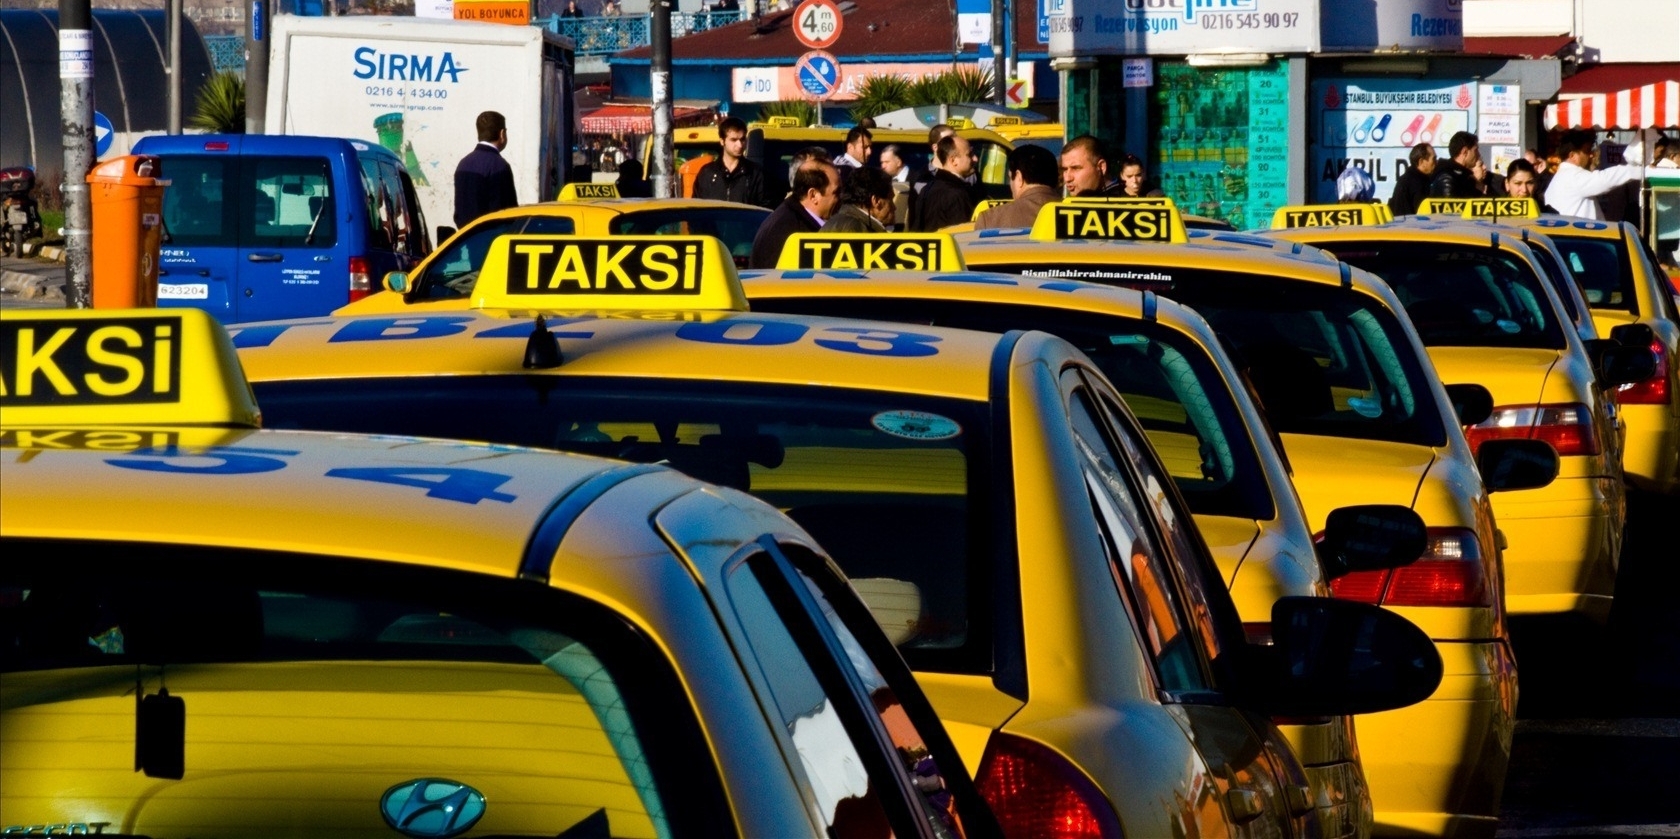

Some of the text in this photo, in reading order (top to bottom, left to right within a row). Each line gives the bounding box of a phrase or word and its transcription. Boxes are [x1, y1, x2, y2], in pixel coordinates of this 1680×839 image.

[459, 8, 524, 19] YOL BOYUNCA
[1095, 12, 1299, 34] Rezervasyon 0216 545 90 97
[353, 46, 469, 84] SIRMA
[366, 86, 393, 97] 0216
[1431, 202, 1464, 214] TAK
